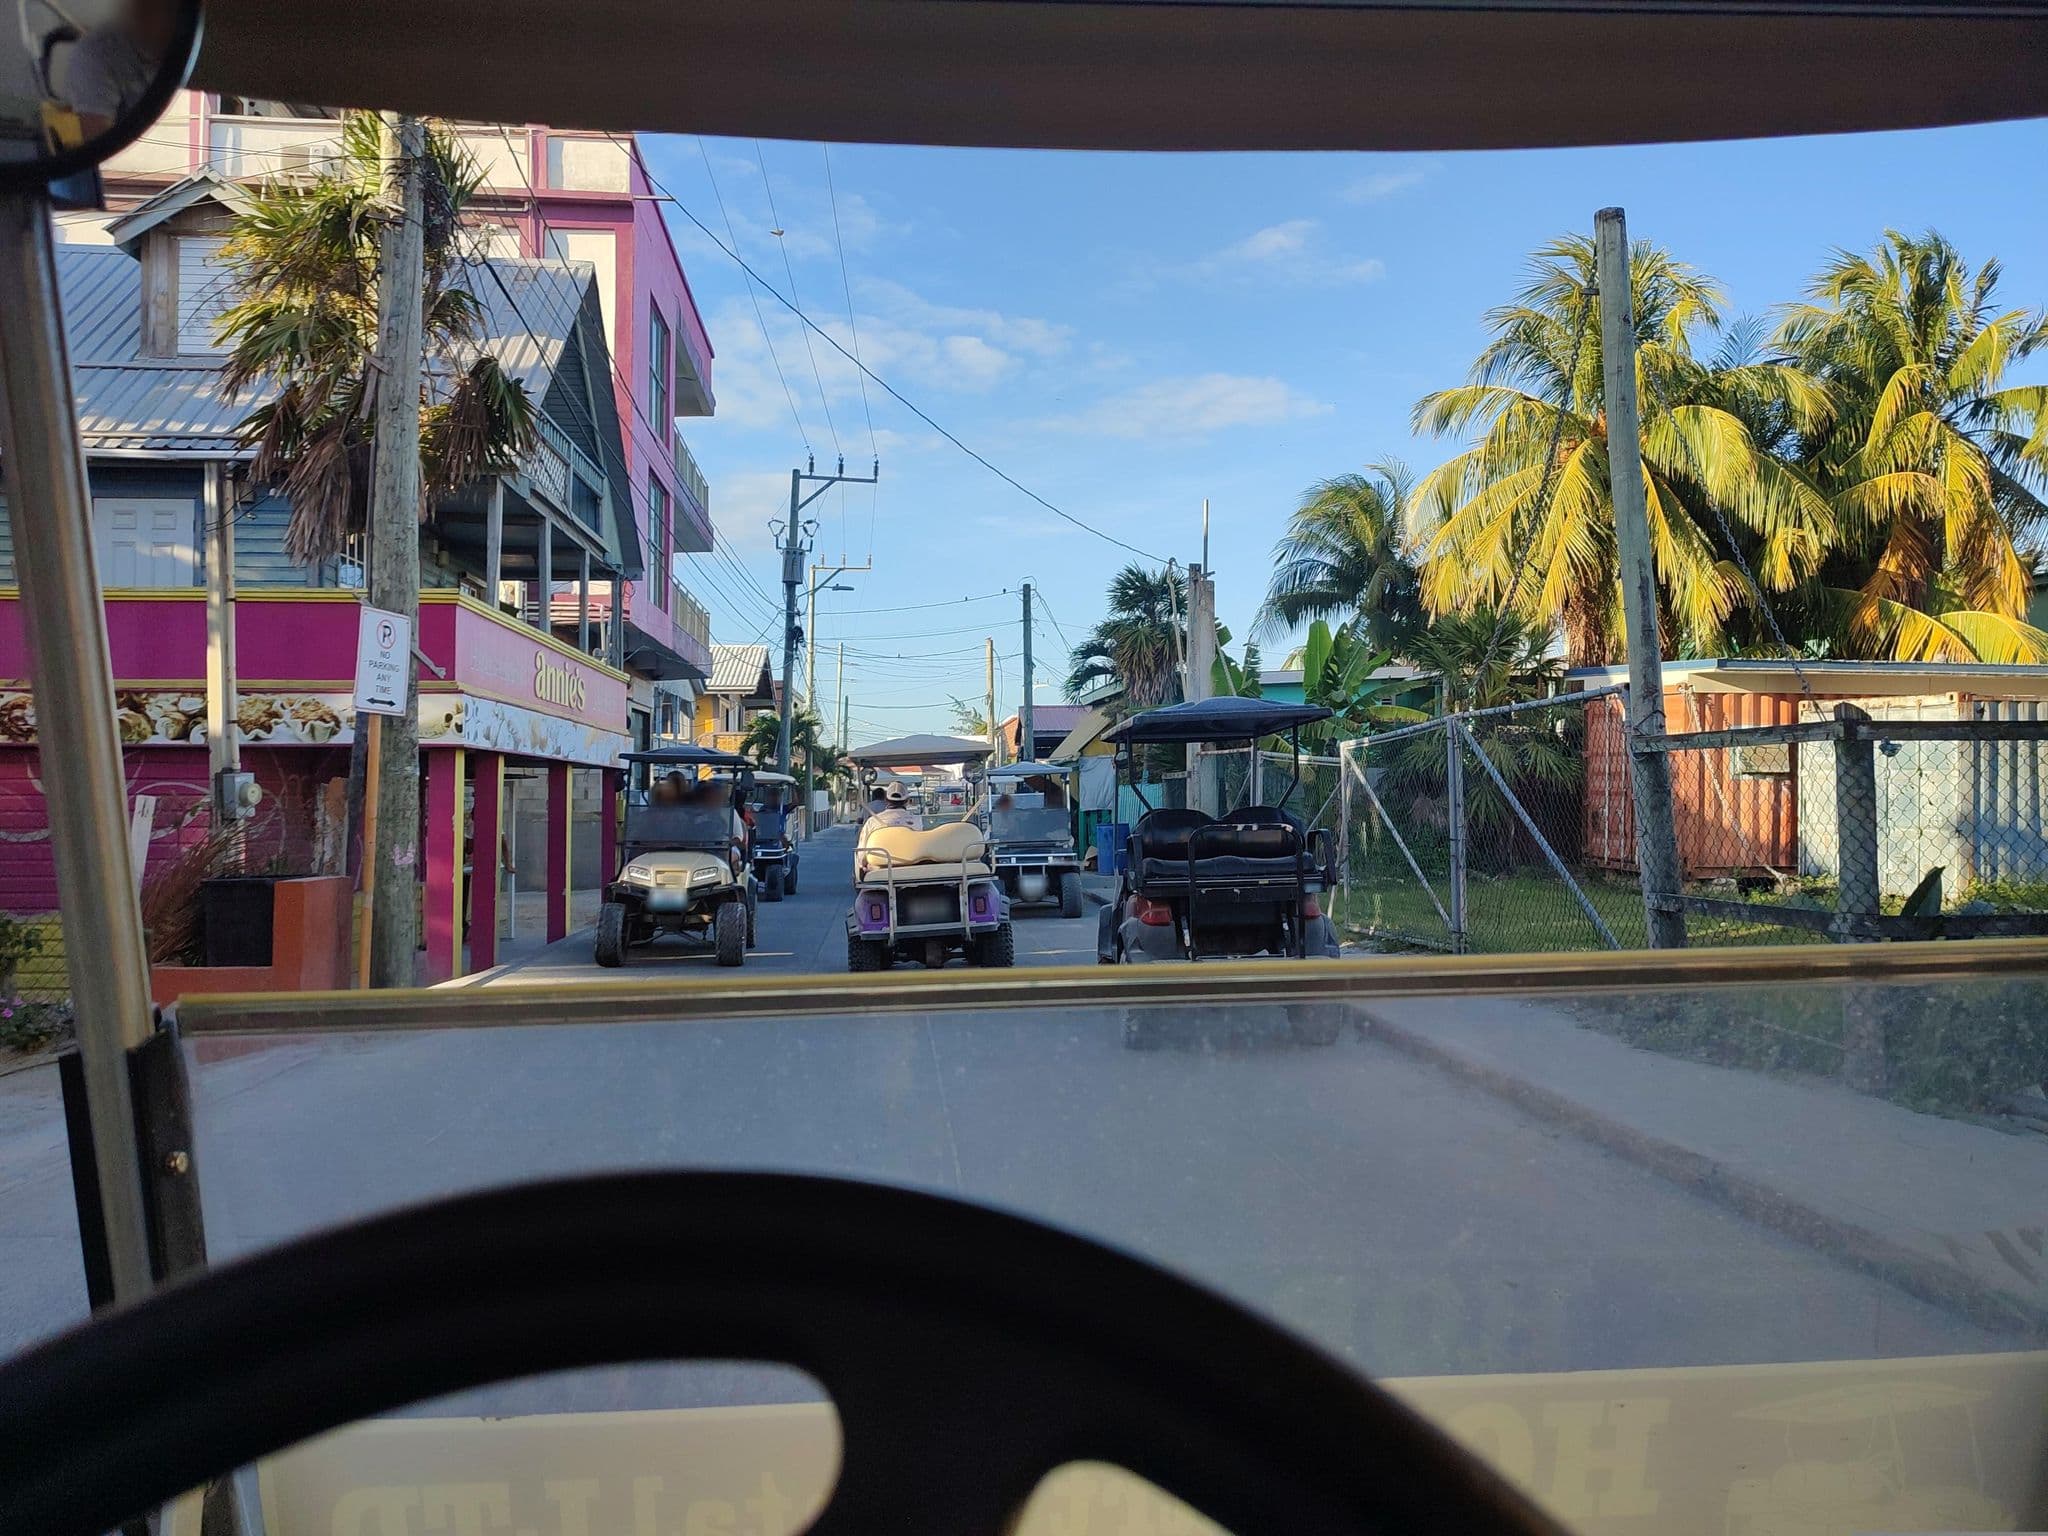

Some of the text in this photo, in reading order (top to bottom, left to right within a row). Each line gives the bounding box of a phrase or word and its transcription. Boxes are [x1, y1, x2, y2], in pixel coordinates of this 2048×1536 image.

[380, 651, 391, 660] NO
[368, 660, 400, 673] PARKING
[376, 673, 392, 683] ANY
[534, 648, 586, 711] annie's
[375, 684, 392, 695] TIME
